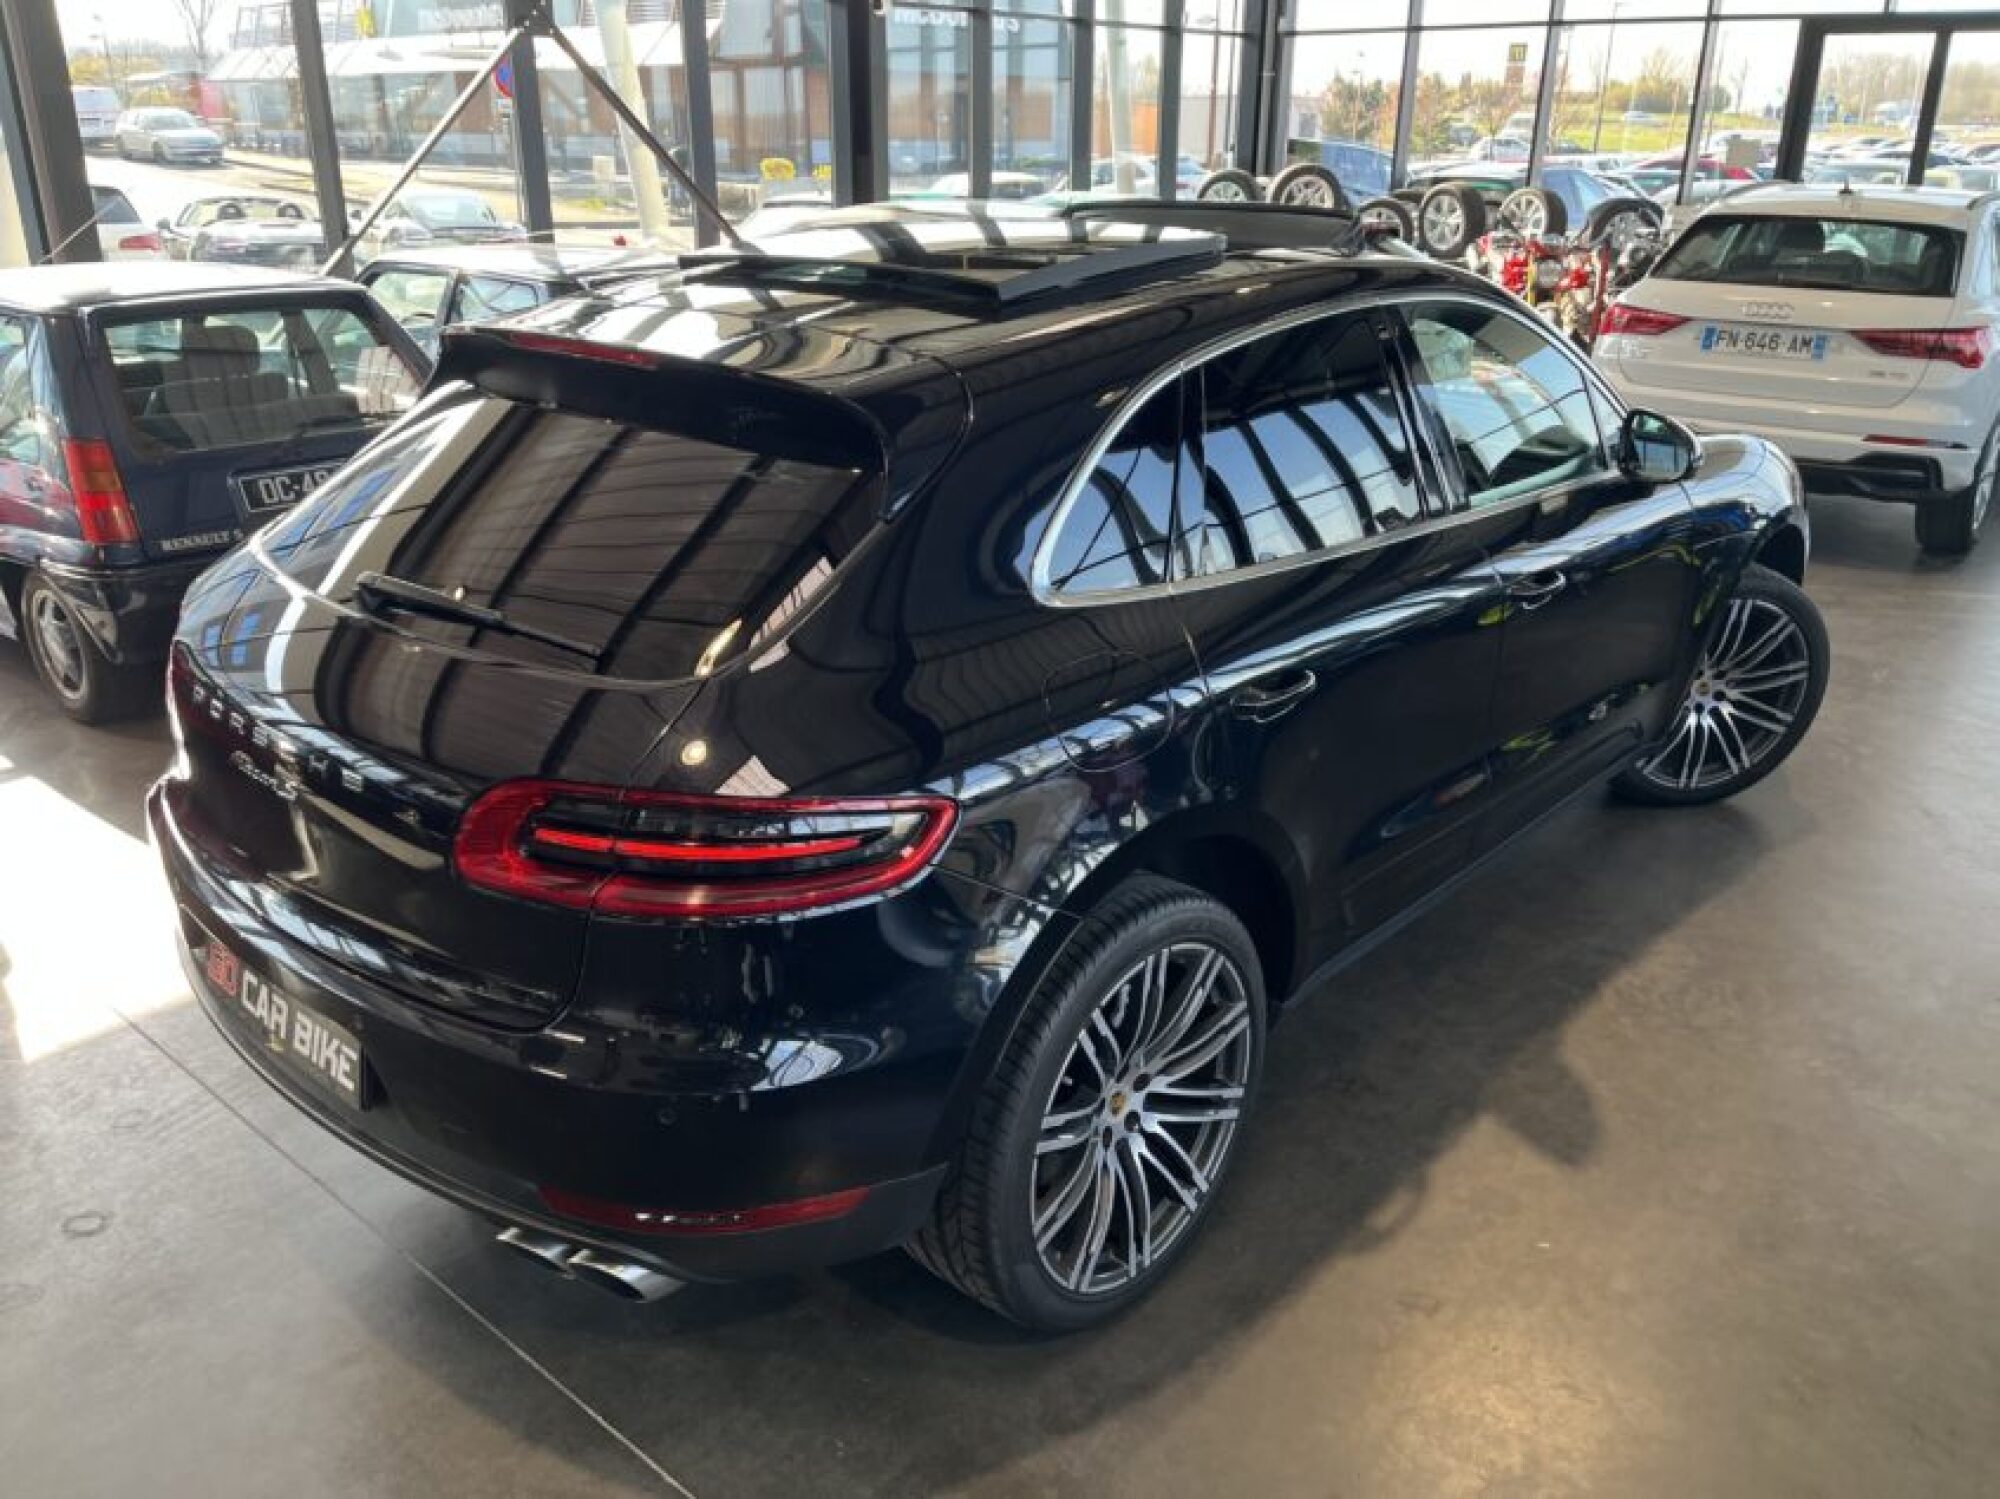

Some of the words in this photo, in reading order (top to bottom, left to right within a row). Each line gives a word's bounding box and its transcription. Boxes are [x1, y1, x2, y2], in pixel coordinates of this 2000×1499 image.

[161, 530, 230, 551] RENAULT
[193, 682, 364, 793] PORSCHE
[240, 969, 289, 1039] CAR
[293, 1012, 358, 1091] BIKE
